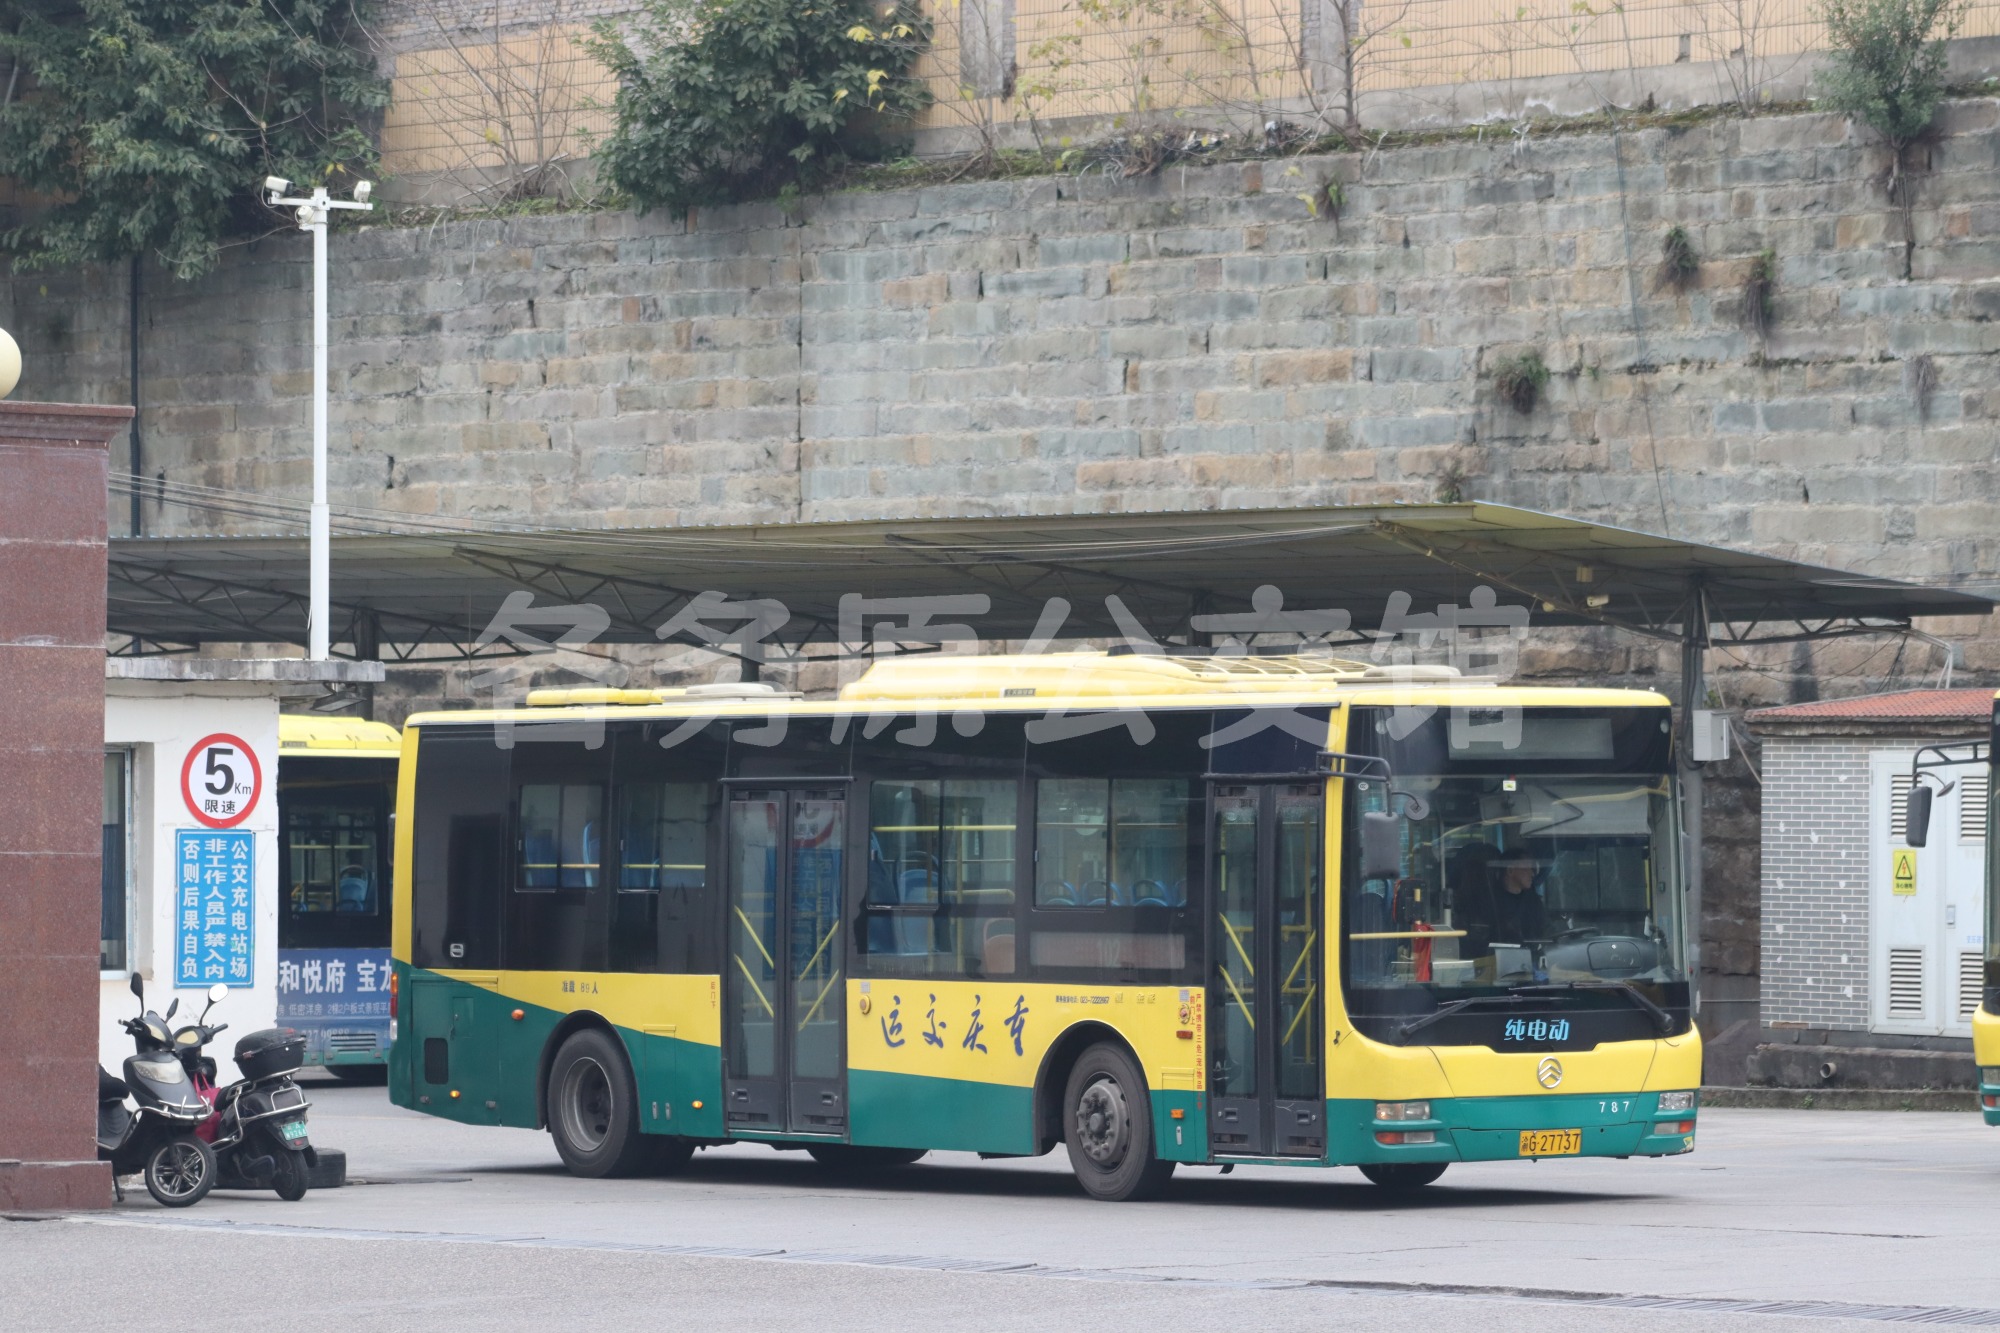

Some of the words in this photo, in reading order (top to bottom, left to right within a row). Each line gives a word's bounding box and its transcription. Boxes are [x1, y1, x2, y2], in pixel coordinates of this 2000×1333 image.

[204, 747, 235, 796] 5
[234, 782, 252, 795] Km
[204, 799, 236, 815] 限速
[182, 839, 201, 979] 否则后果自负
[203, 838, 228, 980] 非工作人员严禁入内
[230, 839, 249, 979] 公交充电站场
[279, 959, 346, 994] 和悦府
[1503, 1018, 1570, 1041] 纯电动
[1599, 1101, 1630, 1113] 787
